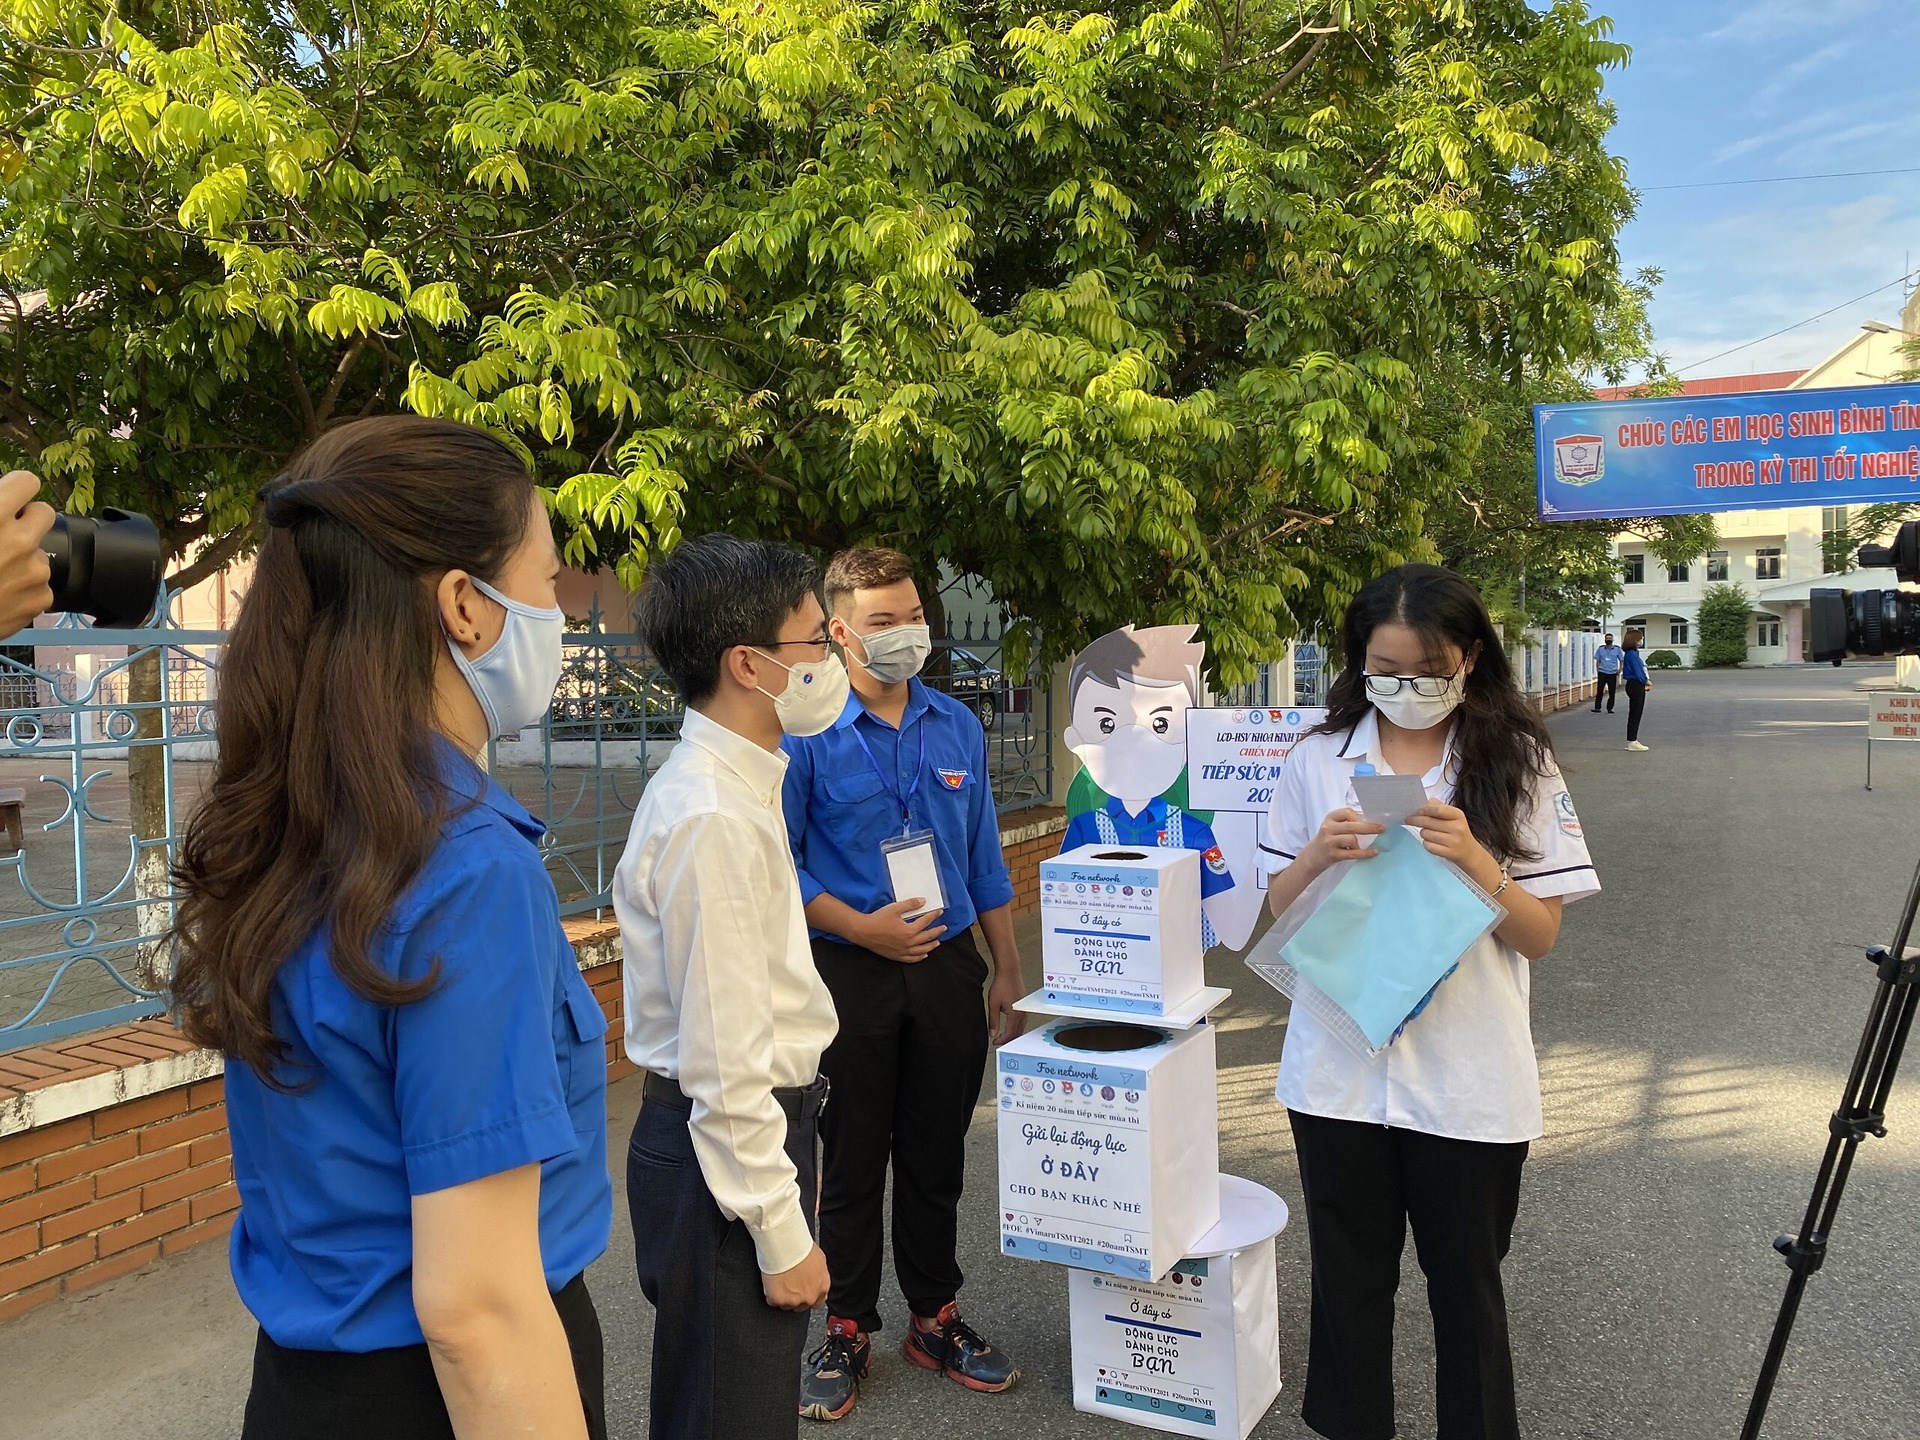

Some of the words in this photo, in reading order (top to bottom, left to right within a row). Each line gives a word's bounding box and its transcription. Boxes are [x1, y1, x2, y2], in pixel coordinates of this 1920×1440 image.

[1617, 416, 1667, 448] CHÚC
[1670, 414, 1708, 445] CÁC
[1711, 416, 1742, 442] EM
[1745, 413, 1784, 445] HỌC
[1788, 409, 1835, 438] SINH
[1839, 402, 1885, 434] BÌNH
[1694, 462, 1755, 489] TRONG
[1759, 453, 1786, 485] KỲ
[1788, 456, 1817, 482] THI
[1822, 445, 1857, 481] TỐT
[1861, 445, 1920, 481] NGHIỆ
[1889, 698, 1907, 707] KHU
[1251, 732, 1274, 743] KHOA
[1274, 732, 1295, 743] KINH
[1239, 745, 1266, 757] CHIẾN
[1266, 748, 1289, 760] DỊCH
[1202, 759, 1236, 780] TIẾP
[1236, 761, 1267, 781] SỨC
[1071, 871, 1087, 881] Foe
[1087, 873, 1121, 883] network
[1080, 911, 1090, 924] Ở
[1092, 915, 1110, 930] đây
[1111, 917, 1122, 927] có
[1074, 937, 1103, 948] ĐỘNG
[1106, 941, 1127, 949] LỰC
[1074, 947, 1103, 958] DÀNH
[1106, 951, 1128, 960] CHO
[1036, 1062, 1056, 1075] Foe
[1057, 1066, 1099, 1080] network
[1025, 1102, 1046, 1112] niệm
[1046, 1105, 1057, 1113] 20
[1076, 1109, 1092, 1118] tiếp
[1109, 1114, 1127, 1122] mùa
[1128, 1116, 1140, 1124] thi
[1022, 1123, 1048, 1146] Gửi
[1050, 1126, 1068, 1146] lại
[1070, 1130, 1102, 1156] động
[1105, 1133, 1127, 1155] lực
[1041, 1154, 1054, 1175] Ở
[1060, 1160, 1099, 1182] ĐÂY
[1009, 1184, 1036, 1196] CHO
[1041, 1189, 1067, 1202] BẠN
[1072, 1194, 1108, 1208] KHÁC
[1113, 1201, 1142, 1214] NHÉ
[1002, 1223, 1023, 1233] #FOE
[1025, 1228, 1094, 1246] #VimaruTSMT2021
[1097, 1240, 1149, 1256] #20namTSMT
[1130, 1298, 1140, 1312] Ở
[1142, 1304, 1160, 1322] đây
[1161, 1308, 1172, 1319] có
[1125, 1327, 1154, 1341] ĐỘNG
[1157, 1334, 1178, 1345] LỰC
[1125, 1340, 1154, 1353] DÀNH
[1157, 1346, 1179, 1358] CHO
